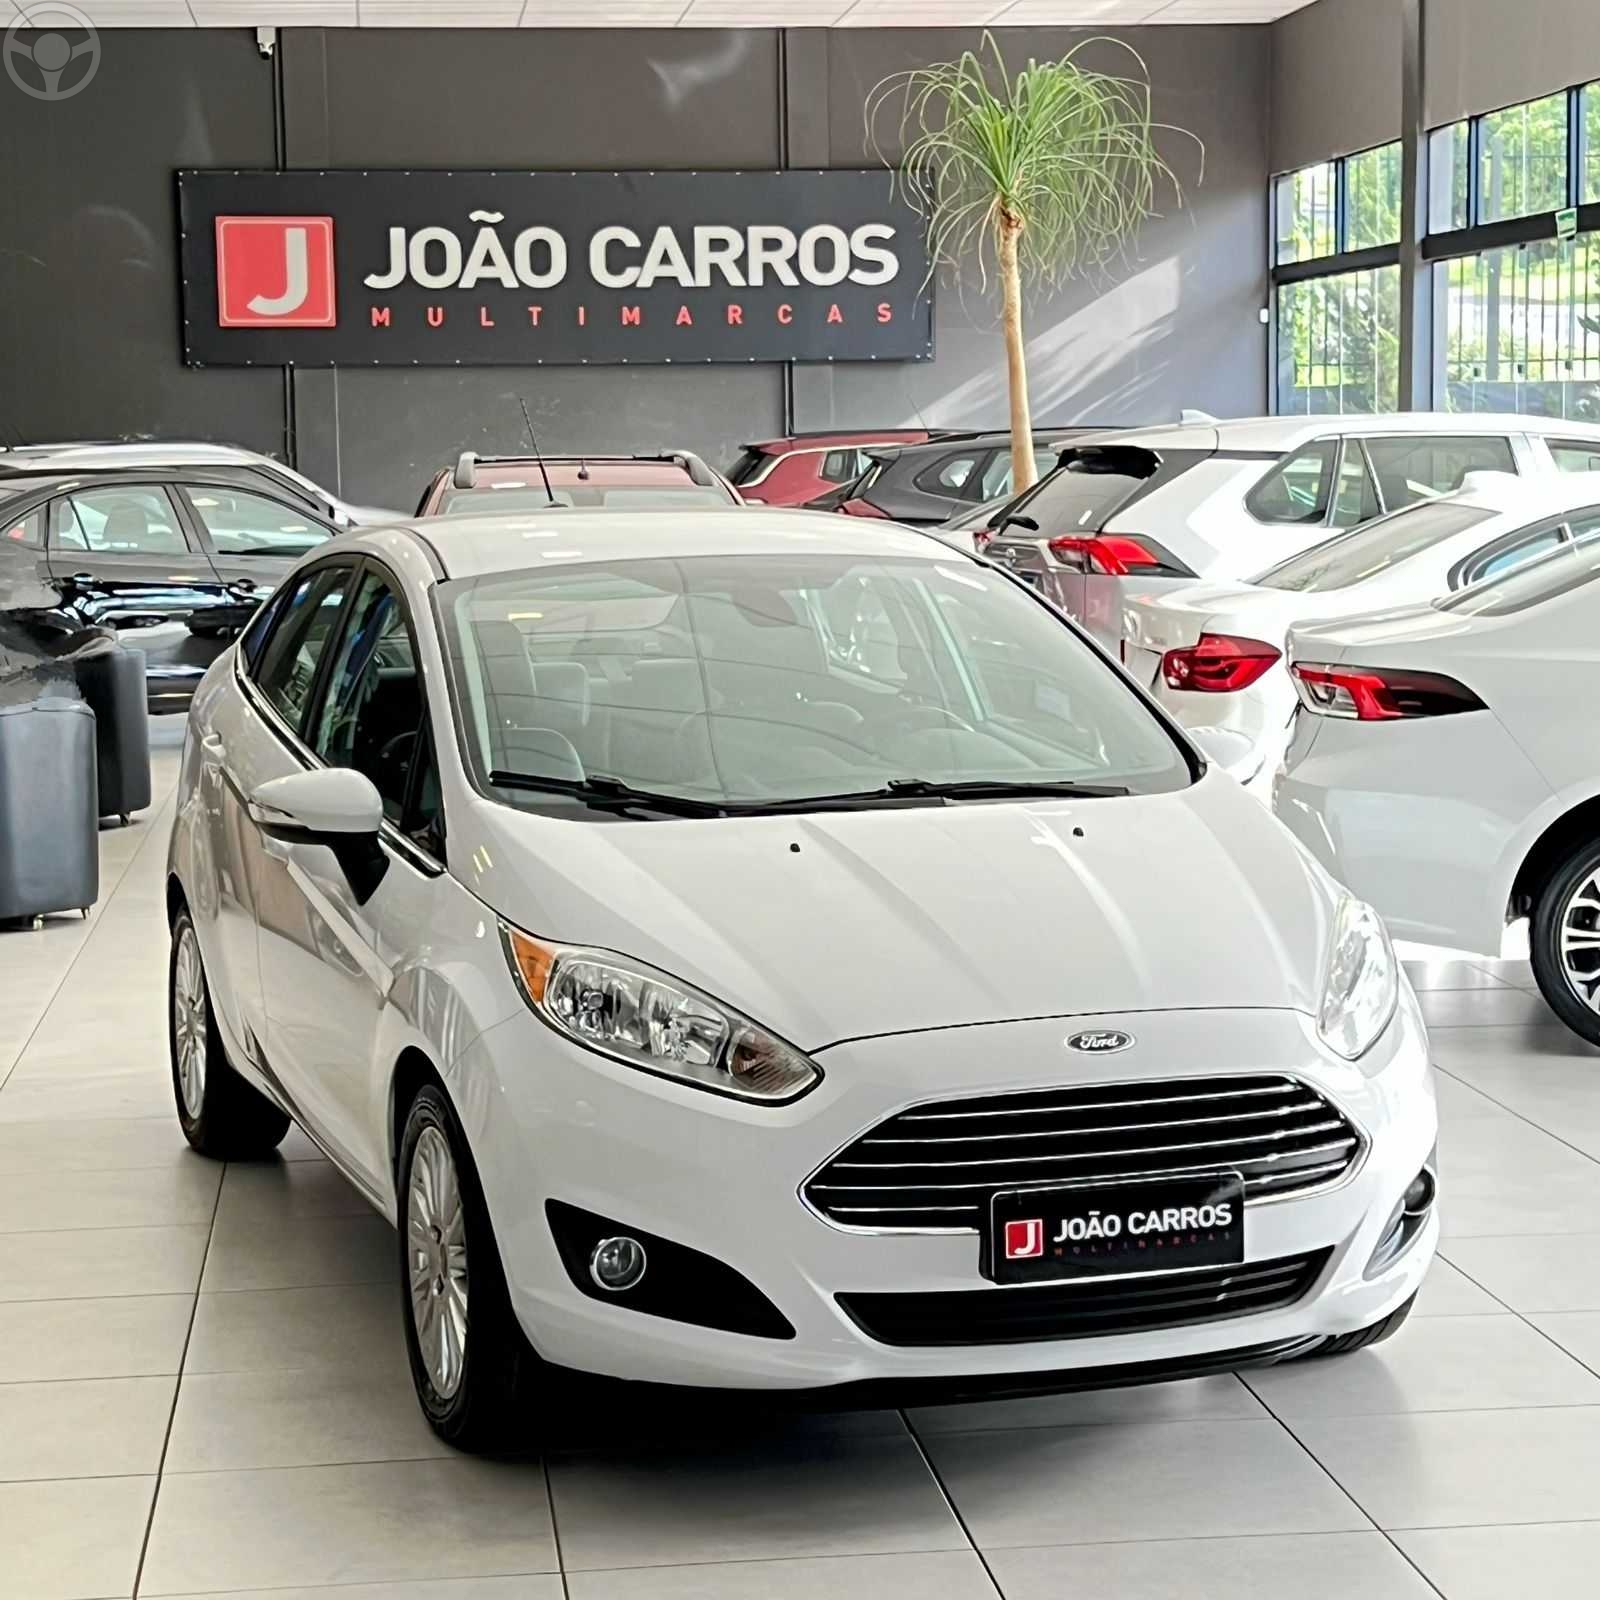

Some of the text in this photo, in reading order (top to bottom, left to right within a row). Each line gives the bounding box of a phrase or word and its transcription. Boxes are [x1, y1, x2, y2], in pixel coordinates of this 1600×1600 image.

[363, 209, 900, 290] JOÃO CARROS
[246, 227, 309, 316] J
[370, 302, 893, 328] MULTIMARCAS
[1080, 1033, 1119, 1049] Ford
[1014, 1222, 1036, 1256] J
[1052, 1203, 1233, 1243] JOÃO CARROS
